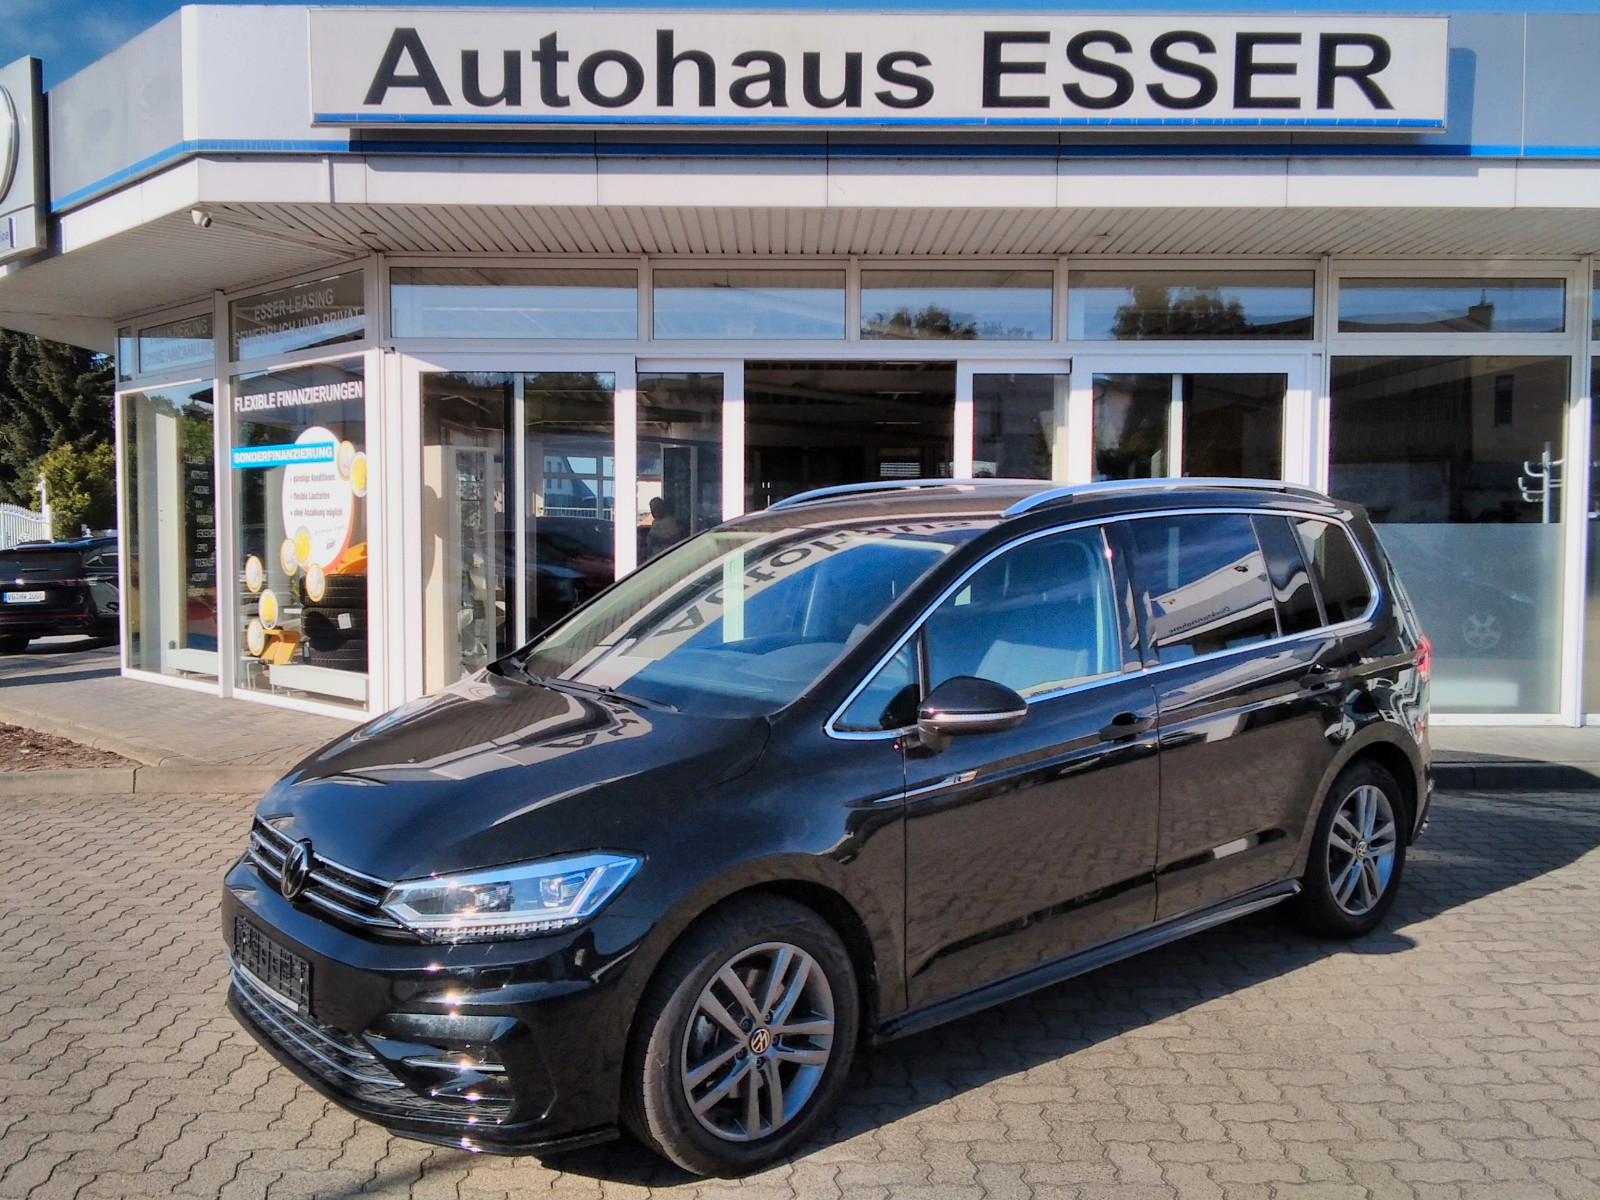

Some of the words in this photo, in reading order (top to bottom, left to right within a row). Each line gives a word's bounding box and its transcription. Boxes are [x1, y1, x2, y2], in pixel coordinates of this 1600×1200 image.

[363, 27, 934, 109] Autohaus
[982, 30, 1396, 111] ESSER
[254, 288, 334, 321] ESSER-LEASING
[234, 392, 276, 412] FLEXIBLE
[277, 381, 363, 407] FINANZIERUNGEN
[233, 446, 333, 464] SONDERFINANZIERUNG
